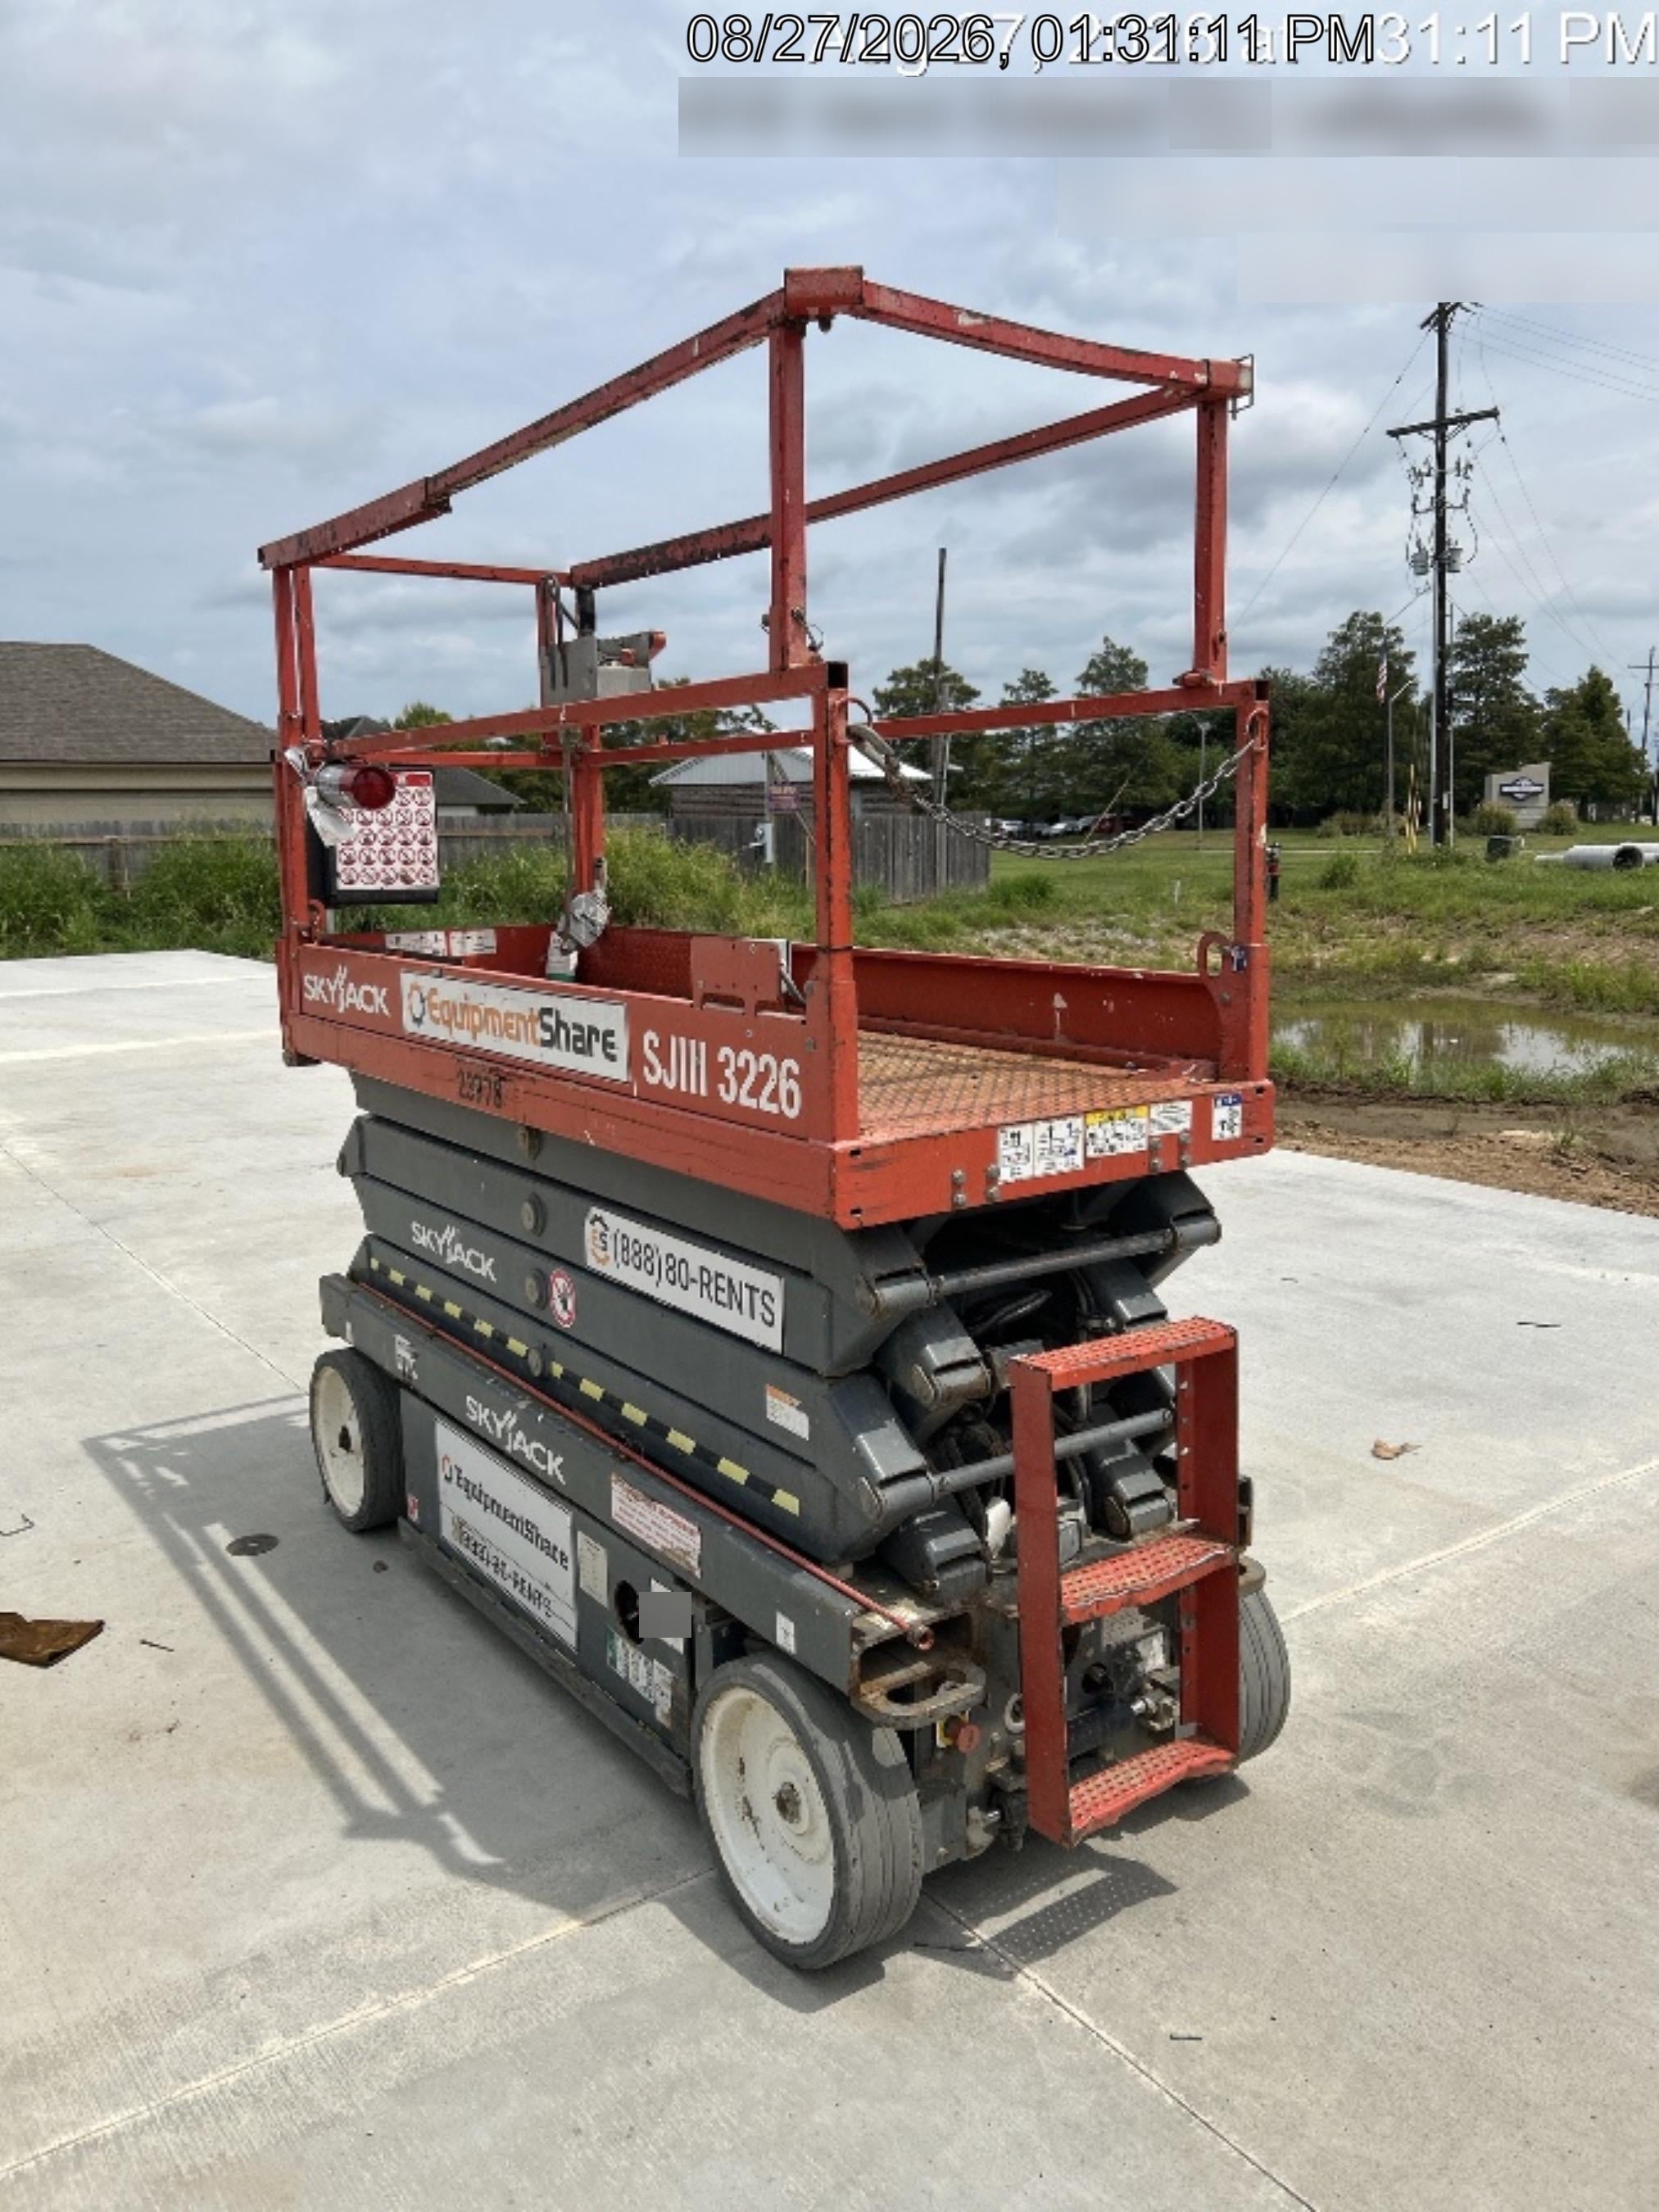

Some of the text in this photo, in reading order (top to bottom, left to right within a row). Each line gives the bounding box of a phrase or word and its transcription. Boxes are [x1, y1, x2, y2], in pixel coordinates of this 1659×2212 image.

[303, 963, 391, 1018] SKYJACK
[427, 987, 618, 1063] EquipmentShare
[717, 1045, 802, 1119] 3226
[410, 1221, 497, 1285] SKYJACK
[466, 1395, 566, 1485] SKYJACK
